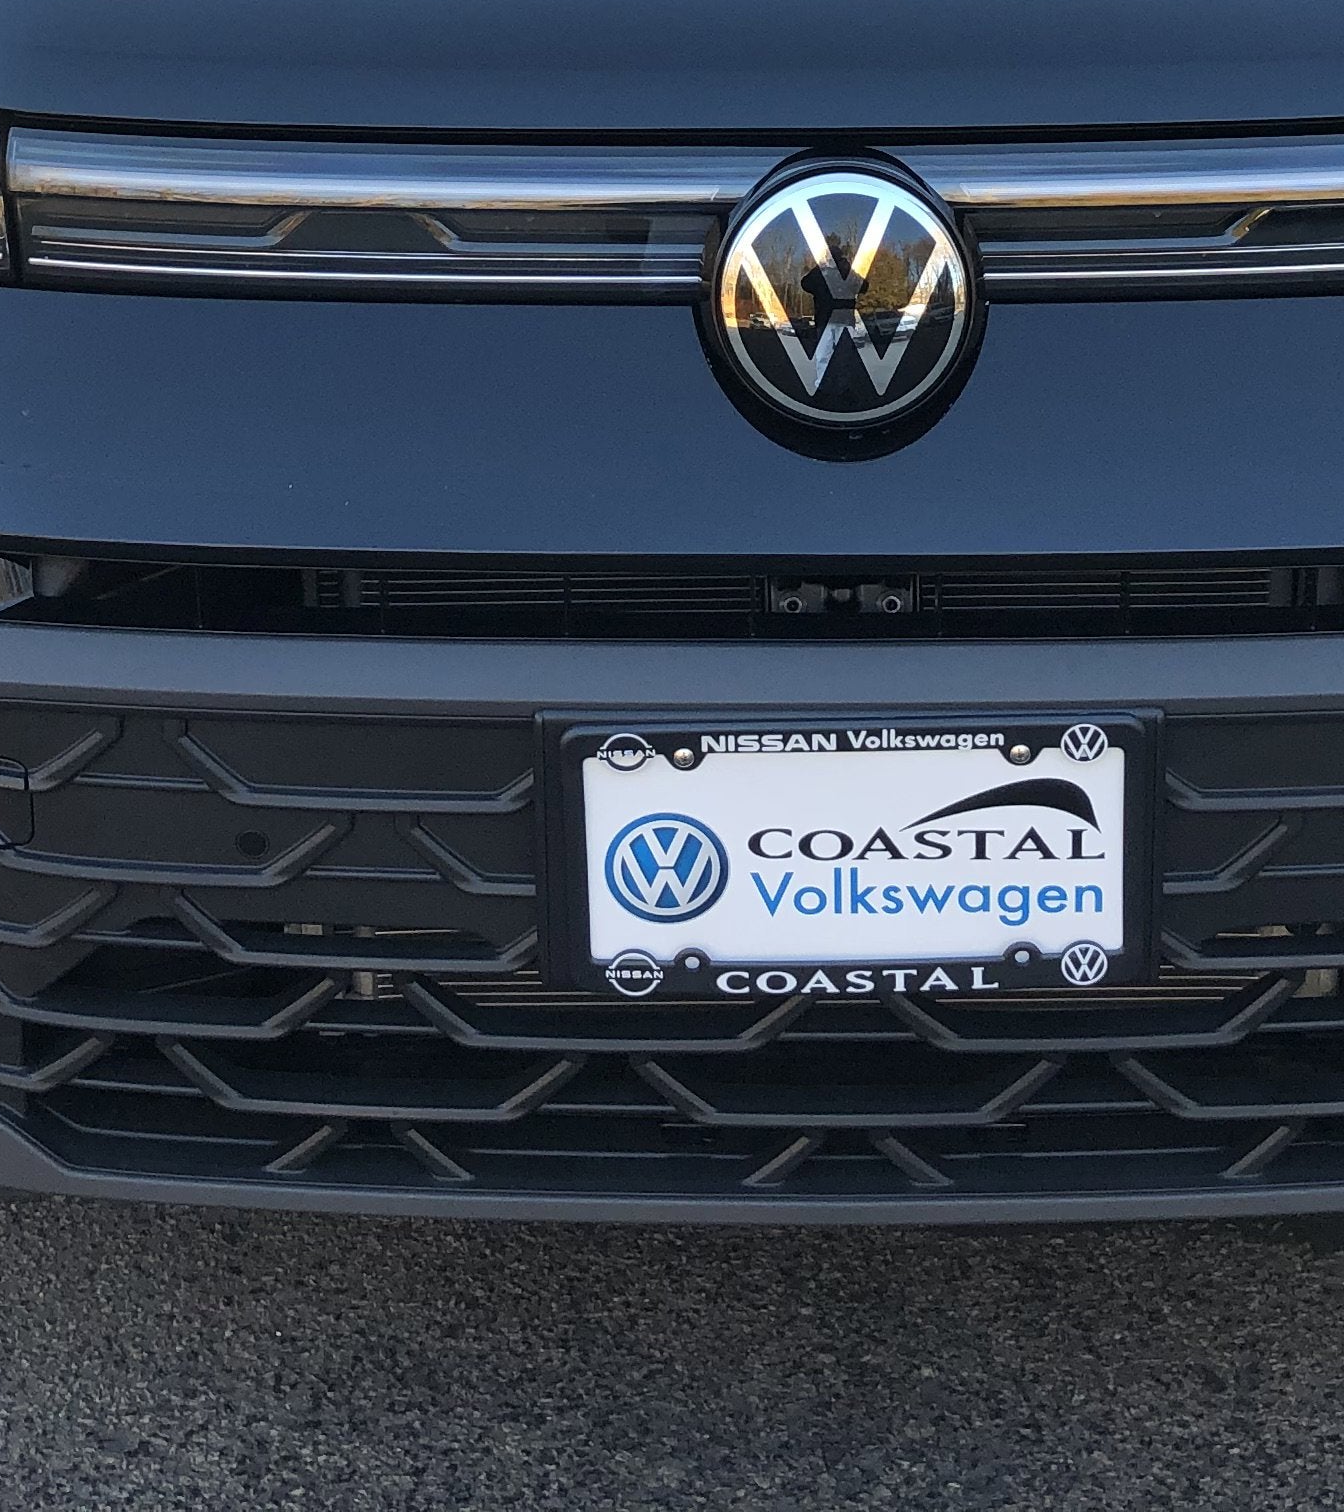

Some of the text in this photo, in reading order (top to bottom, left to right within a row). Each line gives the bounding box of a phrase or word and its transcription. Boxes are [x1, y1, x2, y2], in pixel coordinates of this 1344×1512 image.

[726, 176, 962, 414] VW
[596, 748, 656, 760] NISSAN
[701, 728, 1005, 753] NISSAN Volkswagen
[747, 826, 1106, 861] COASTAL
[749, 867, 1104, 926] Volkswagen
[605, 969, 664, 980] NISSAN
[715, 966, 1000, 994] COASTAL
